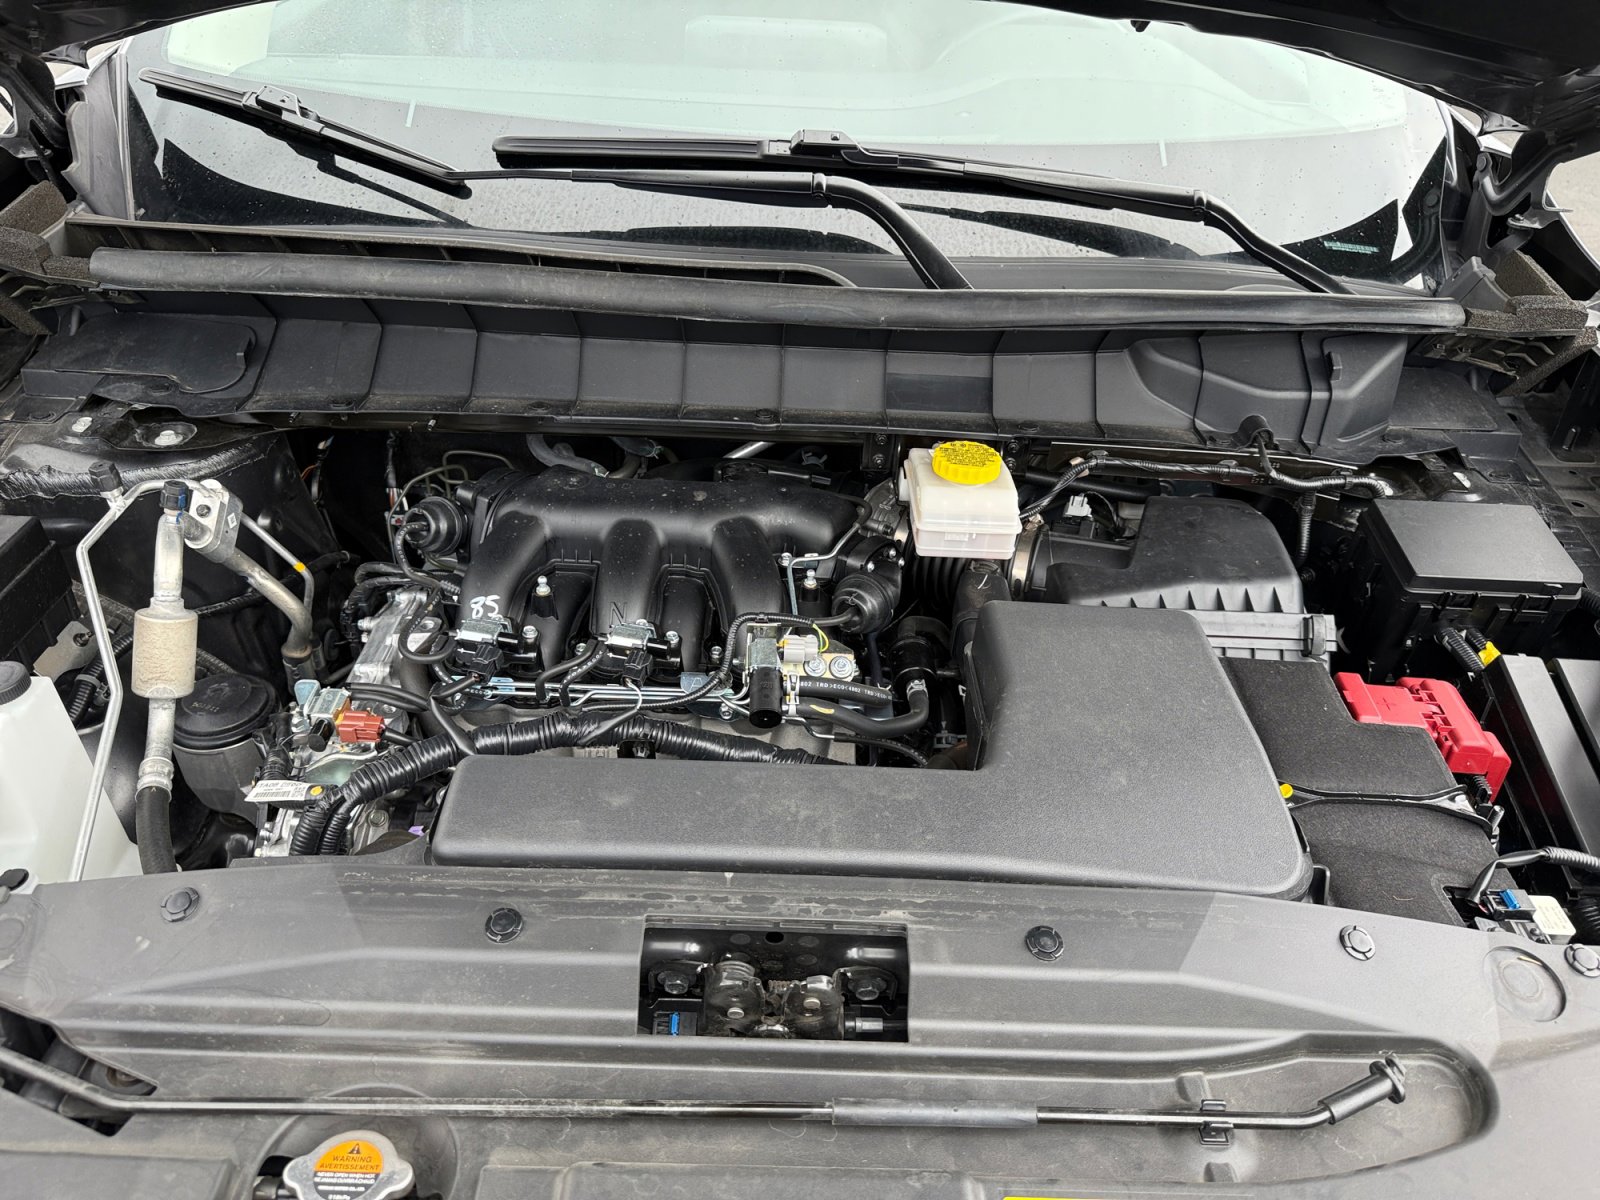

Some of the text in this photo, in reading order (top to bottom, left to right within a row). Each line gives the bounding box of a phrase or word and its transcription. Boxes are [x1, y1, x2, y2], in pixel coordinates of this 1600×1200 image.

[470, 595, 501, 619] 85
[332, 1154, 373, 1162] WARNING
[319, 1162, 380, 1171] AVERTISSEMENT
